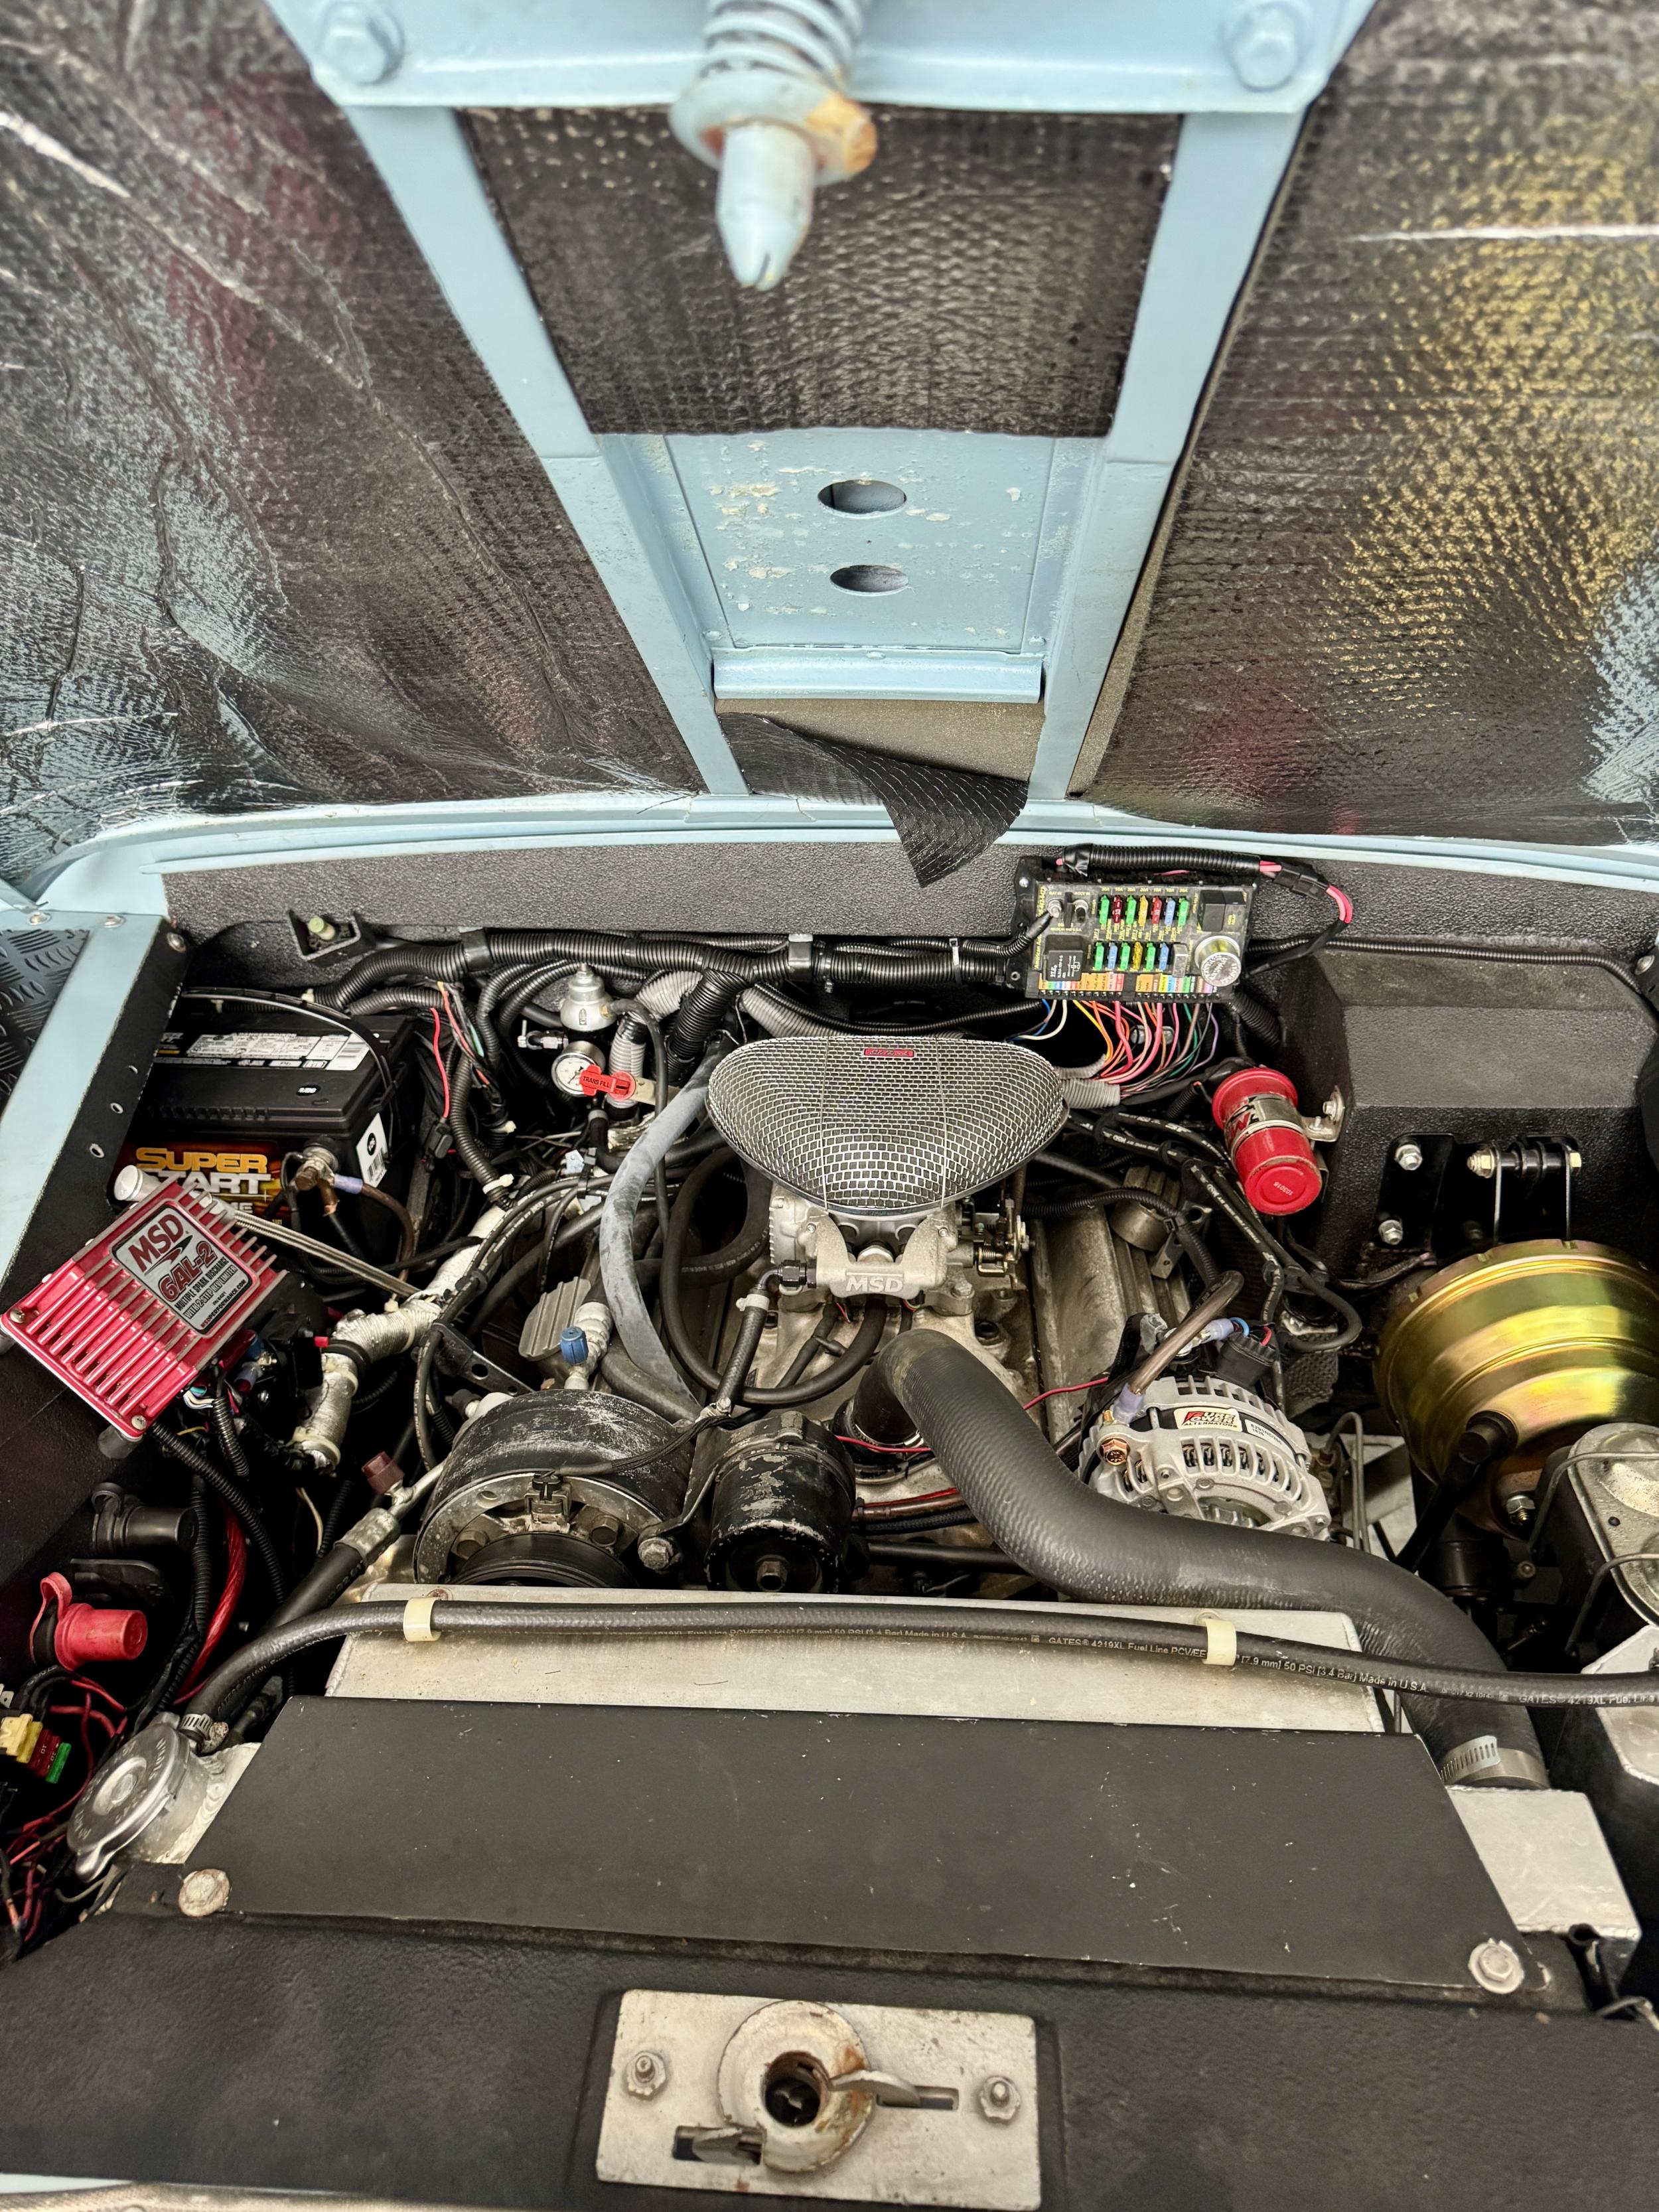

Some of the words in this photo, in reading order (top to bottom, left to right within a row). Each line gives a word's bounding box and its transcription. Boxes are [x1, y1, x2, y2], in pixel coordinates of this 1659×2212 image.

[583, 1076, 599, 1085] TRANS
[1113, 1135, 1126, 1143] MSD
[136, 1147, 268, 1174] SUPER
[1206, 1183, 1220, 1197] MSD
[530, 1201, 545, 1214] MSD
[127, 1214, 184, 1273] MSD
[158, 1240, 218, 1302] 6AL-2
[218, 1264, 239, 1286] LIMITER
[174, 1286, 197, 1311] MULTIPLE
[192, 1273, 210, 1293] SPARK
[206, 1256, 230, 1282] DISCHARGE
[212, 1278, 225, 1293] REV
[845, 1276, 903, 1293] MSD
[196, 1288, 215, 1309] 2-STEP
[182, 1301, 200, 1319] WITH
[1091, 1639, 1126, 1651] 4219XL
[1127, 1643, 1148, 1653] Fuel
[1150, 1645, 1169, 1655] Line
[1241, 1655, 1260, 1666] [7.9
[1261, 1658, 1281, 1670] mm]
[1283, 1662, 1296, 1672] 50
[1298, 1664, 1315, 1675] PSI
[1317, 1666, 1335, 1678] [3.4
[1336, 1668, 1358, 1683] Bar]
[1359, 1672, 1386, 1686] Made
[1388, 1676, 1398, 1688] in
